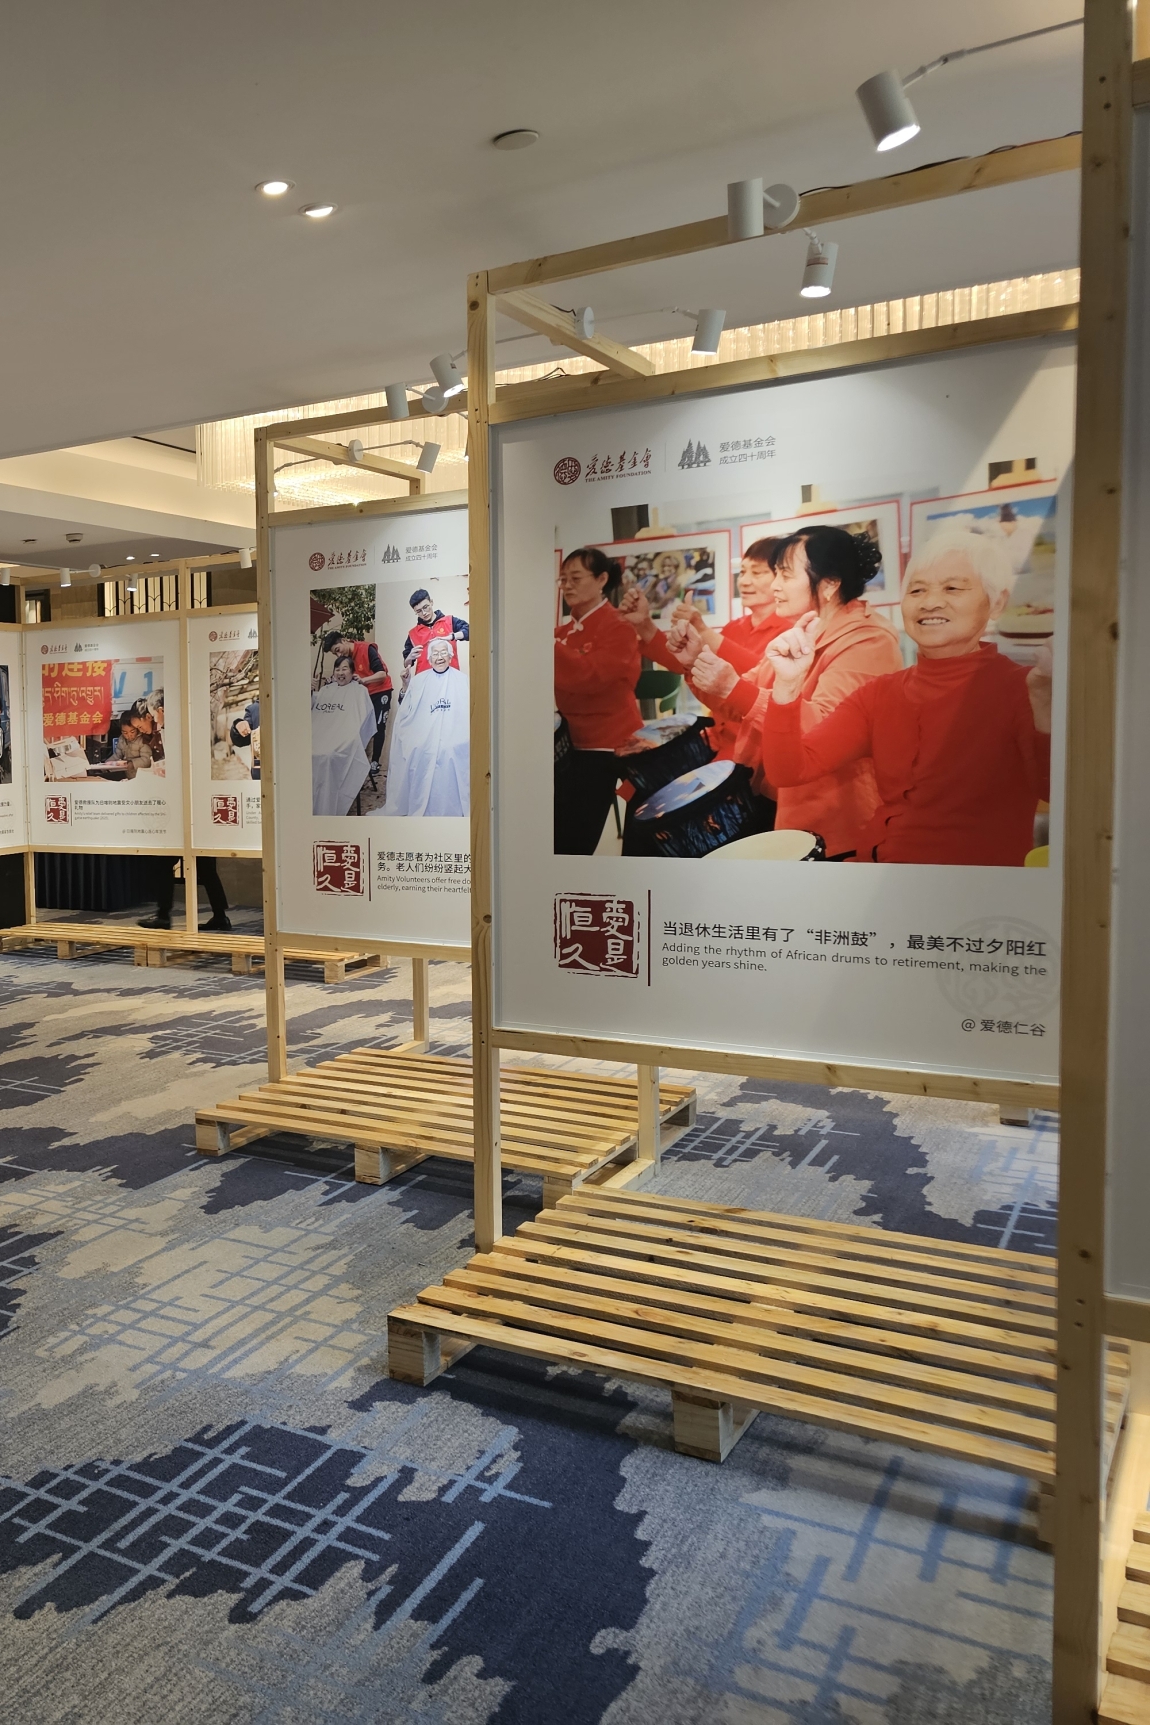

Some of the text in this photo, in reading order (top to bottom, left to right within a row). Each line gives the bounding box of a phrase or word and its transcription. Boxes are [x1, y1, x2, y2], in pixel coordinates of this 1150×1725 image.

[719, 435, 776, 453] 爱德基金会
[719, 449, 776, 465] 成立四十周年
[616, 470, 652, 479] FOUNDATION
[43, 711, 103, 727] 爱德基金会
[377, 851, 471, 863] 爱德志愿者为社区里的
[377, 862, 471, 874] 务。老人们纷纷竖起大
[377, 884, 401, 892] elderly,
[401, 885, 426, 893] earning
[427, 885, 442, 893] their
[662, 942, 1047, 977] Adding the rhythm of African drums to retirement, making the
[662, 955, 767, 971] golden years shine.
[961, 1018, 1046, 1037] @ 爱德仁谷
